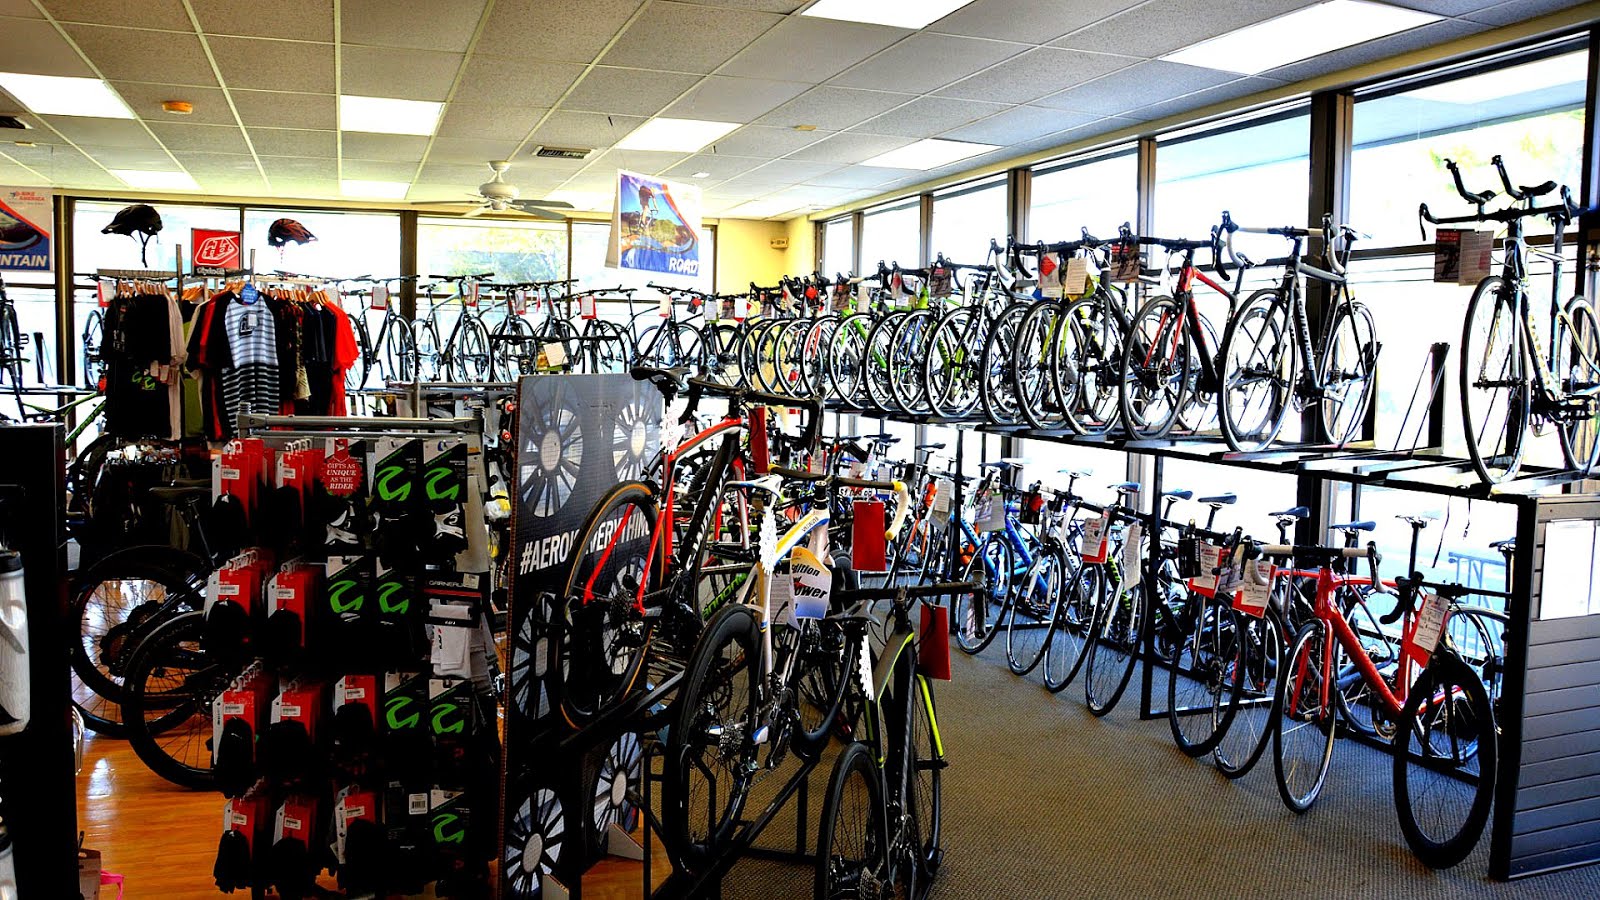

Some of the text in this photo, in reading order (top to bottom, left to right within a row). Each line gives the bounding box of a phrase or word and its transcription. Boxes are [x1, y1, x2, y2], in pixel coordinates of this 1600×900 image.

[0, 253, 47, 267] NTAIN
[669, 256, 699, 274] ROAD
[1297, 299, 1316, 371] cannondale
